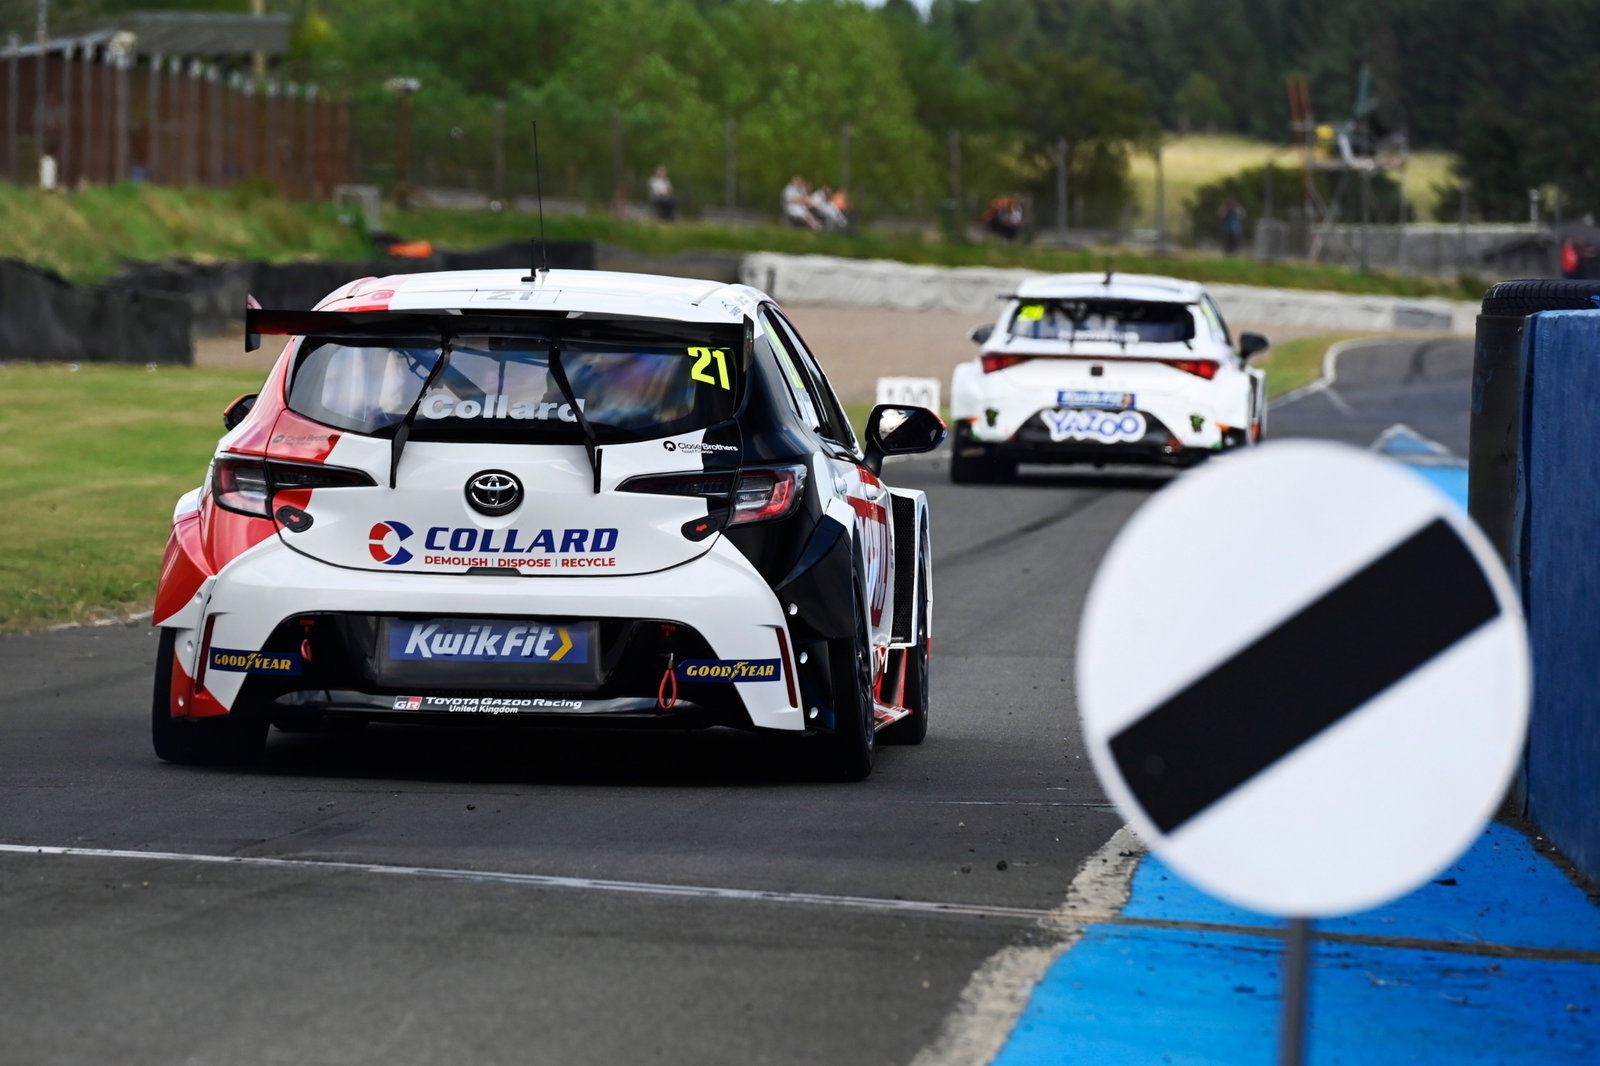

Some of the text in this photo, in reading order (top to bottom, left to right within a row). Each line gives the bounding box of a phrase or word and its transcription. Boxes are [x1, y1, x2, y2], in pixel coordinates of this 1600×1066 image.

[687, 347, 731, 390] 21
[422, 394, 586, 422] Collard
[677, 442, 738, 452] Close Brothers
[425, 527, 618, 553] COLLARD
[424, 555, 616, 568] DEMOLISH DISPOSE RECYCLE
[393, 696, 582, 711] GR TOYOTA GAZOO Racing
[449, 704, 519, 715] United Kingdom
